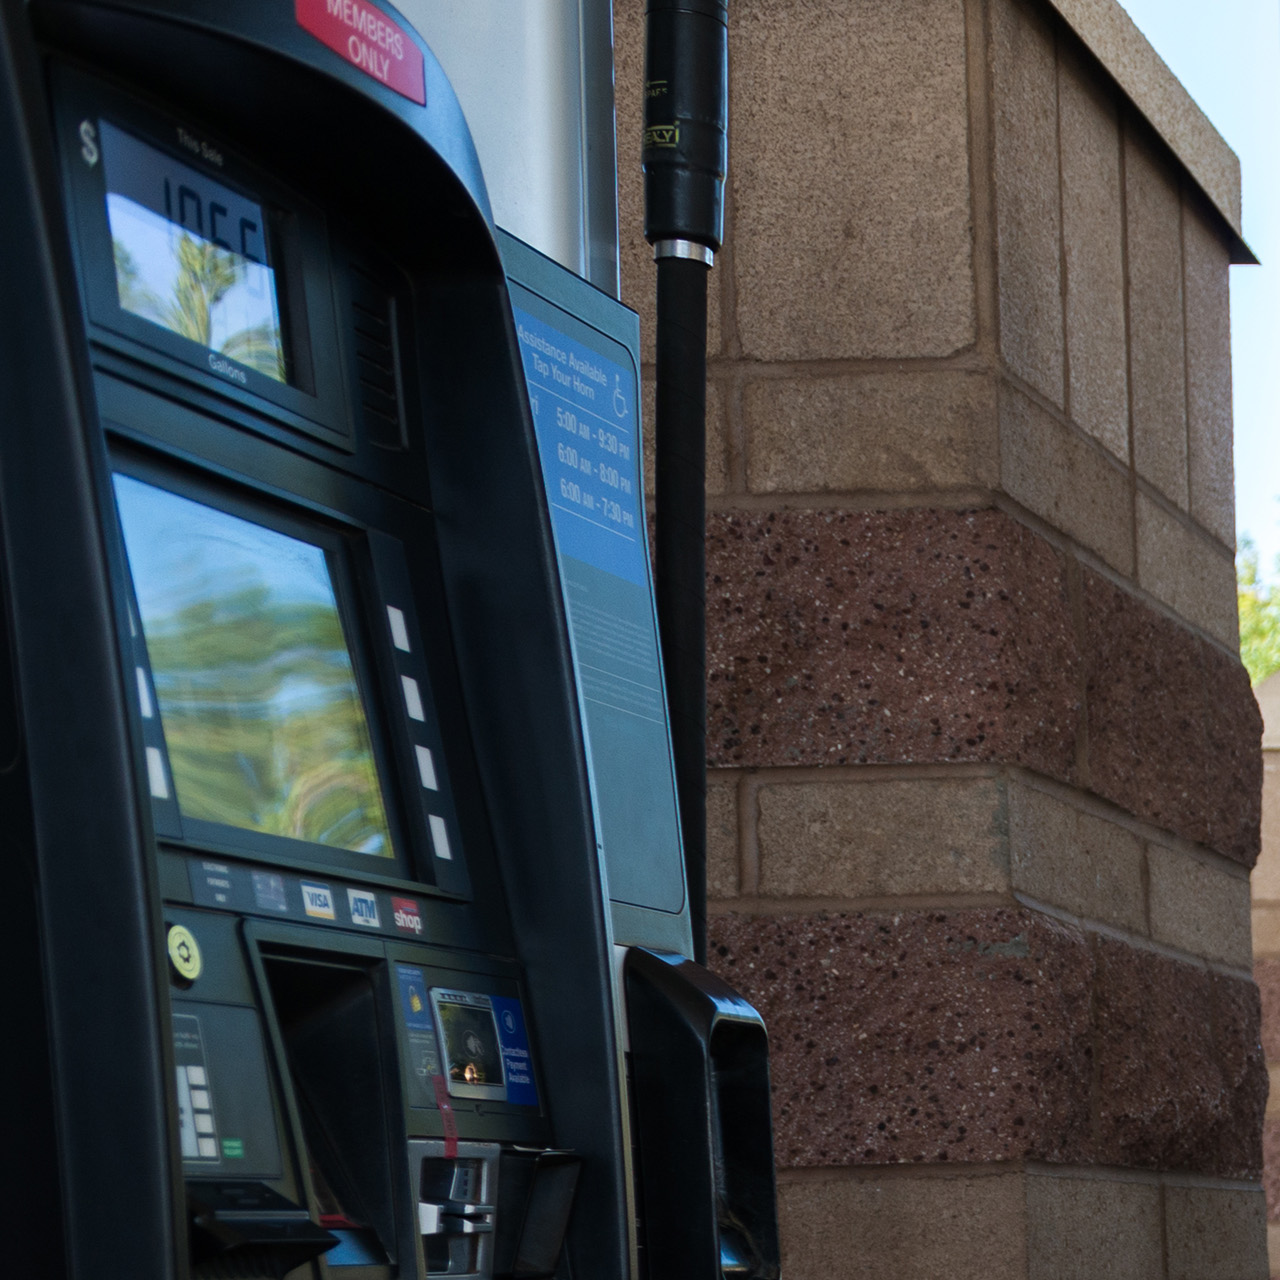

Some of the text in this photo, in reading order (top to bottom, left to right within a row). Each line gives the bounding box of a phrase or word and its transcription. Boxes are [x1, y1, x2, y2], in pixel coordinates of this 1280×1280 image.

[326, 0, 404, 60] MEMBERS
[348, 35, 389, 81] ONLY
[79, 119, 99, 168] $
[208, 353, 247, 384] Gallons
[518, 324, 607, 387] Assistance Available
[532, 353, 595, 400] Tap Your Horn
[556, 407, 577, 435] 5:00
[598, 428, 618, 455] 9:30
[557, 442, 578, 469] 6:00
[601, 497, 621, 523] 7:30
[306, 890, 330, 909] VISA
[351, 897, 377, 920] ATM
[394, 911, 422, 934] shop
